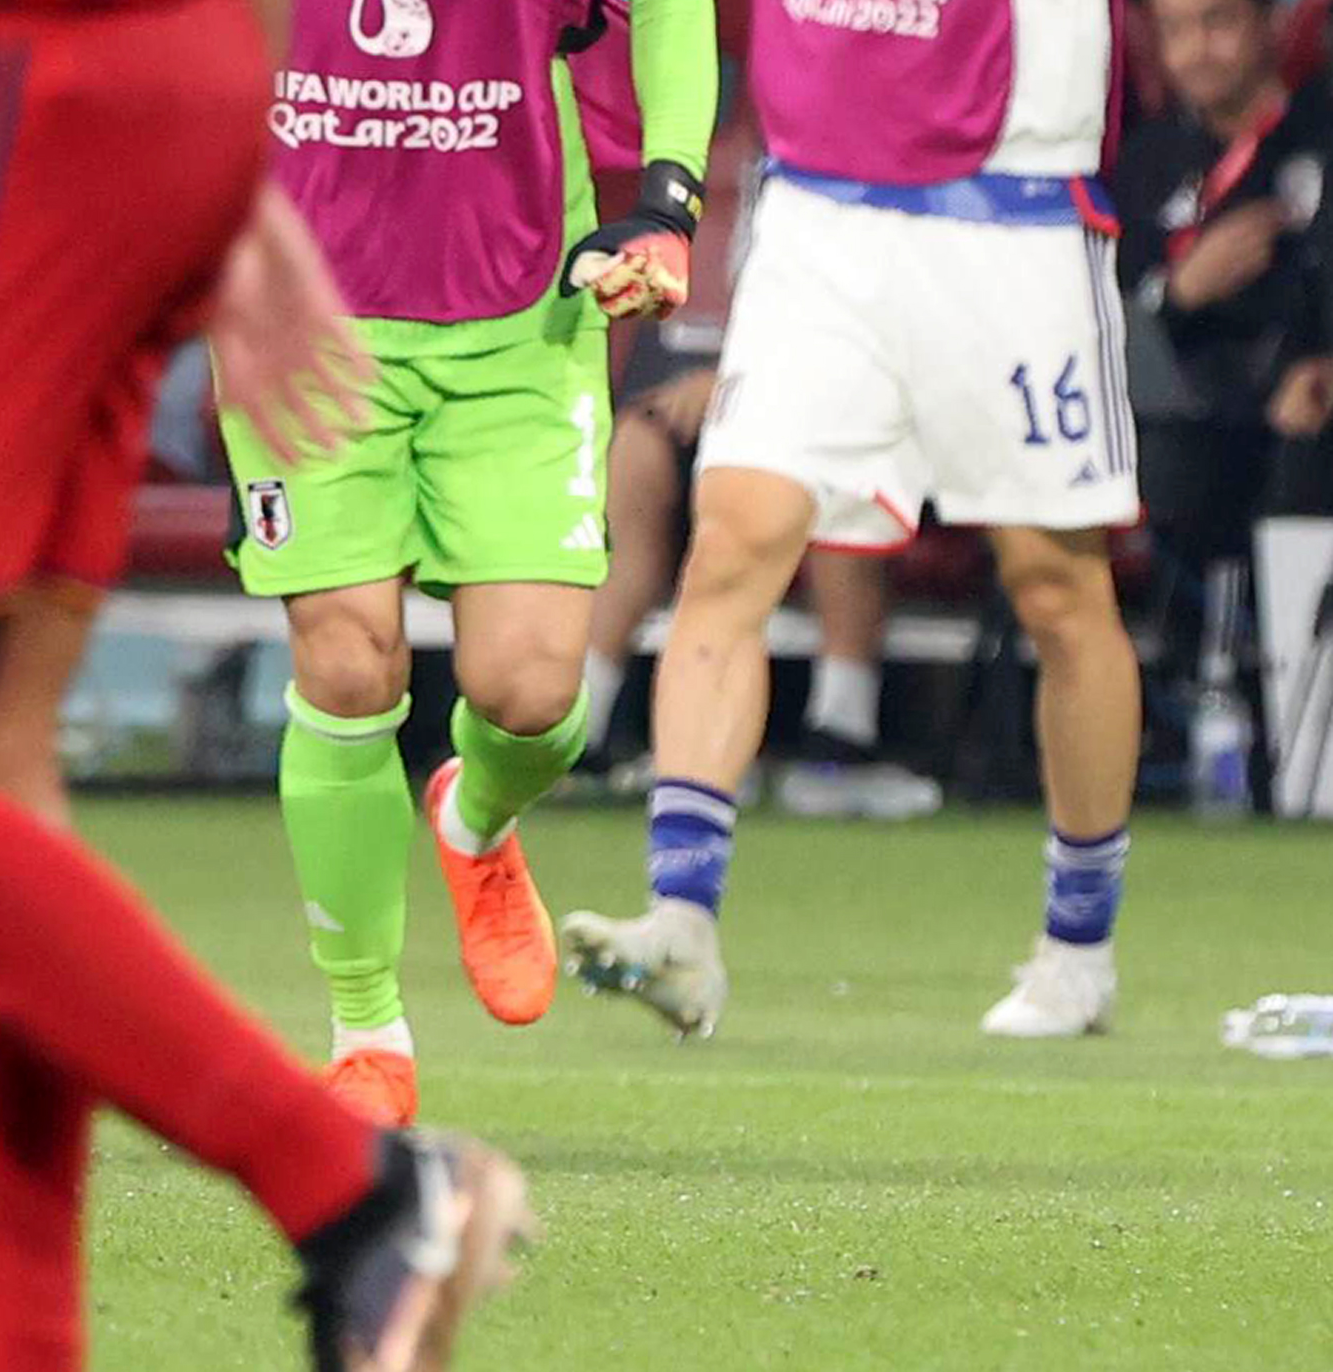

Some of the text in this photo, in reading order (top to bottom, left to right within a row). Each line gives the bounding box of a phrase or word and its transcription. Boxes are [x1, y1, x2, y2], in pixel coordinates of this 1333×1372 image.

[274, 70, 523, 113] IFA WORLD CUP
[566, 394, 597, 498] 1
[1009, 354, 1092, 446] 16
